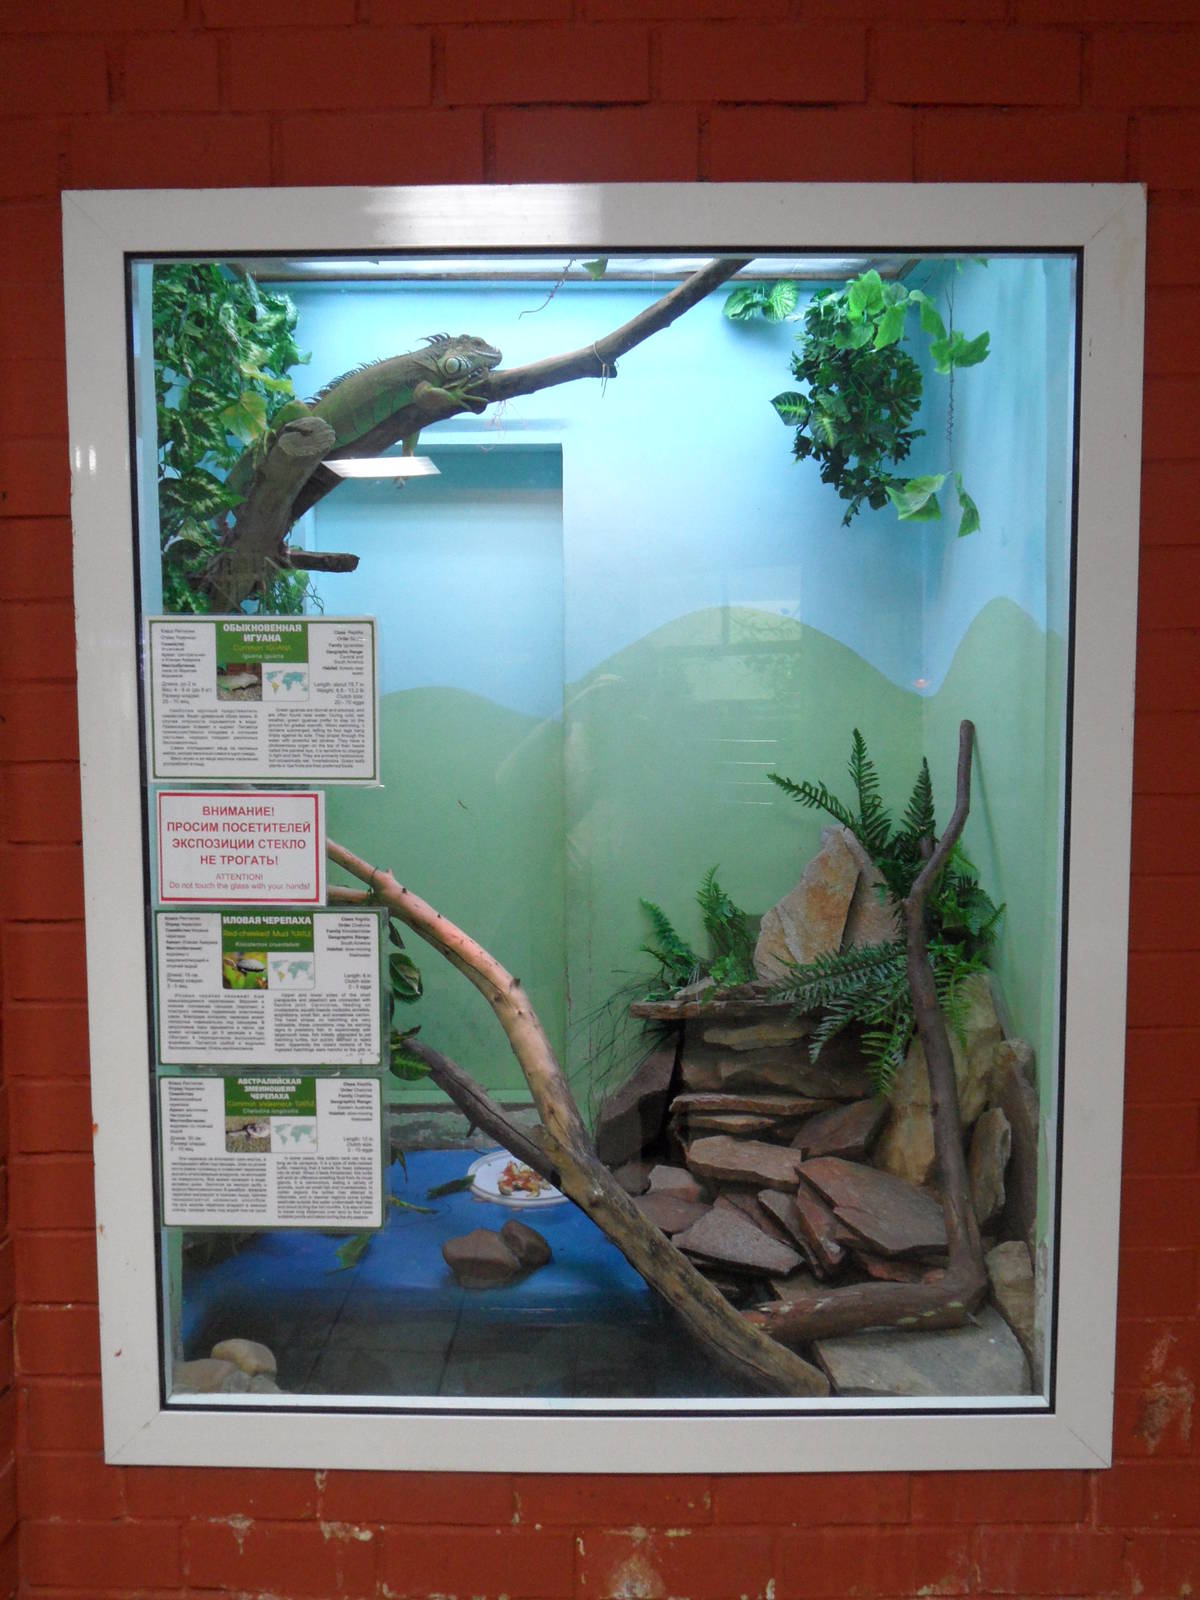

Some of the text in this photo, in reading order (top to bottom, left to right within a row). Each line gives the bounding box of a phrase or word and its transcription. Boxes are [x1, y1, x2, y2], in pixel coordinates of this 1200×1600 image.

[223, 623, 302, 632] ОБЫКНОВЕННАЯ
[243, 633, 282, 642] ИГУАНА
[202, 806, 275, 816] ВНИМАНИЕ!
[167, 821, 311, 832] ПРОСИМ ПОСЕТИТЕЛЕЙ
[172, 838, 306, 850] ЭКСПОЗИЦИИ СТЕКЛО
[200, 855, 279, 865] НЕ ТРОГАТЬ!
[216, 873, 263, 881] ATTENTION!
[169, 881, 180, 889] Do
[195, 881, 215, 889] touch
[216, 881, 228, 889] the
[230, 882, 249, 890] glass
[268, 883, 283, 891] your
[223, 916, 312, 925] ИЛОВАЯ ЧЕРЕПАХА
